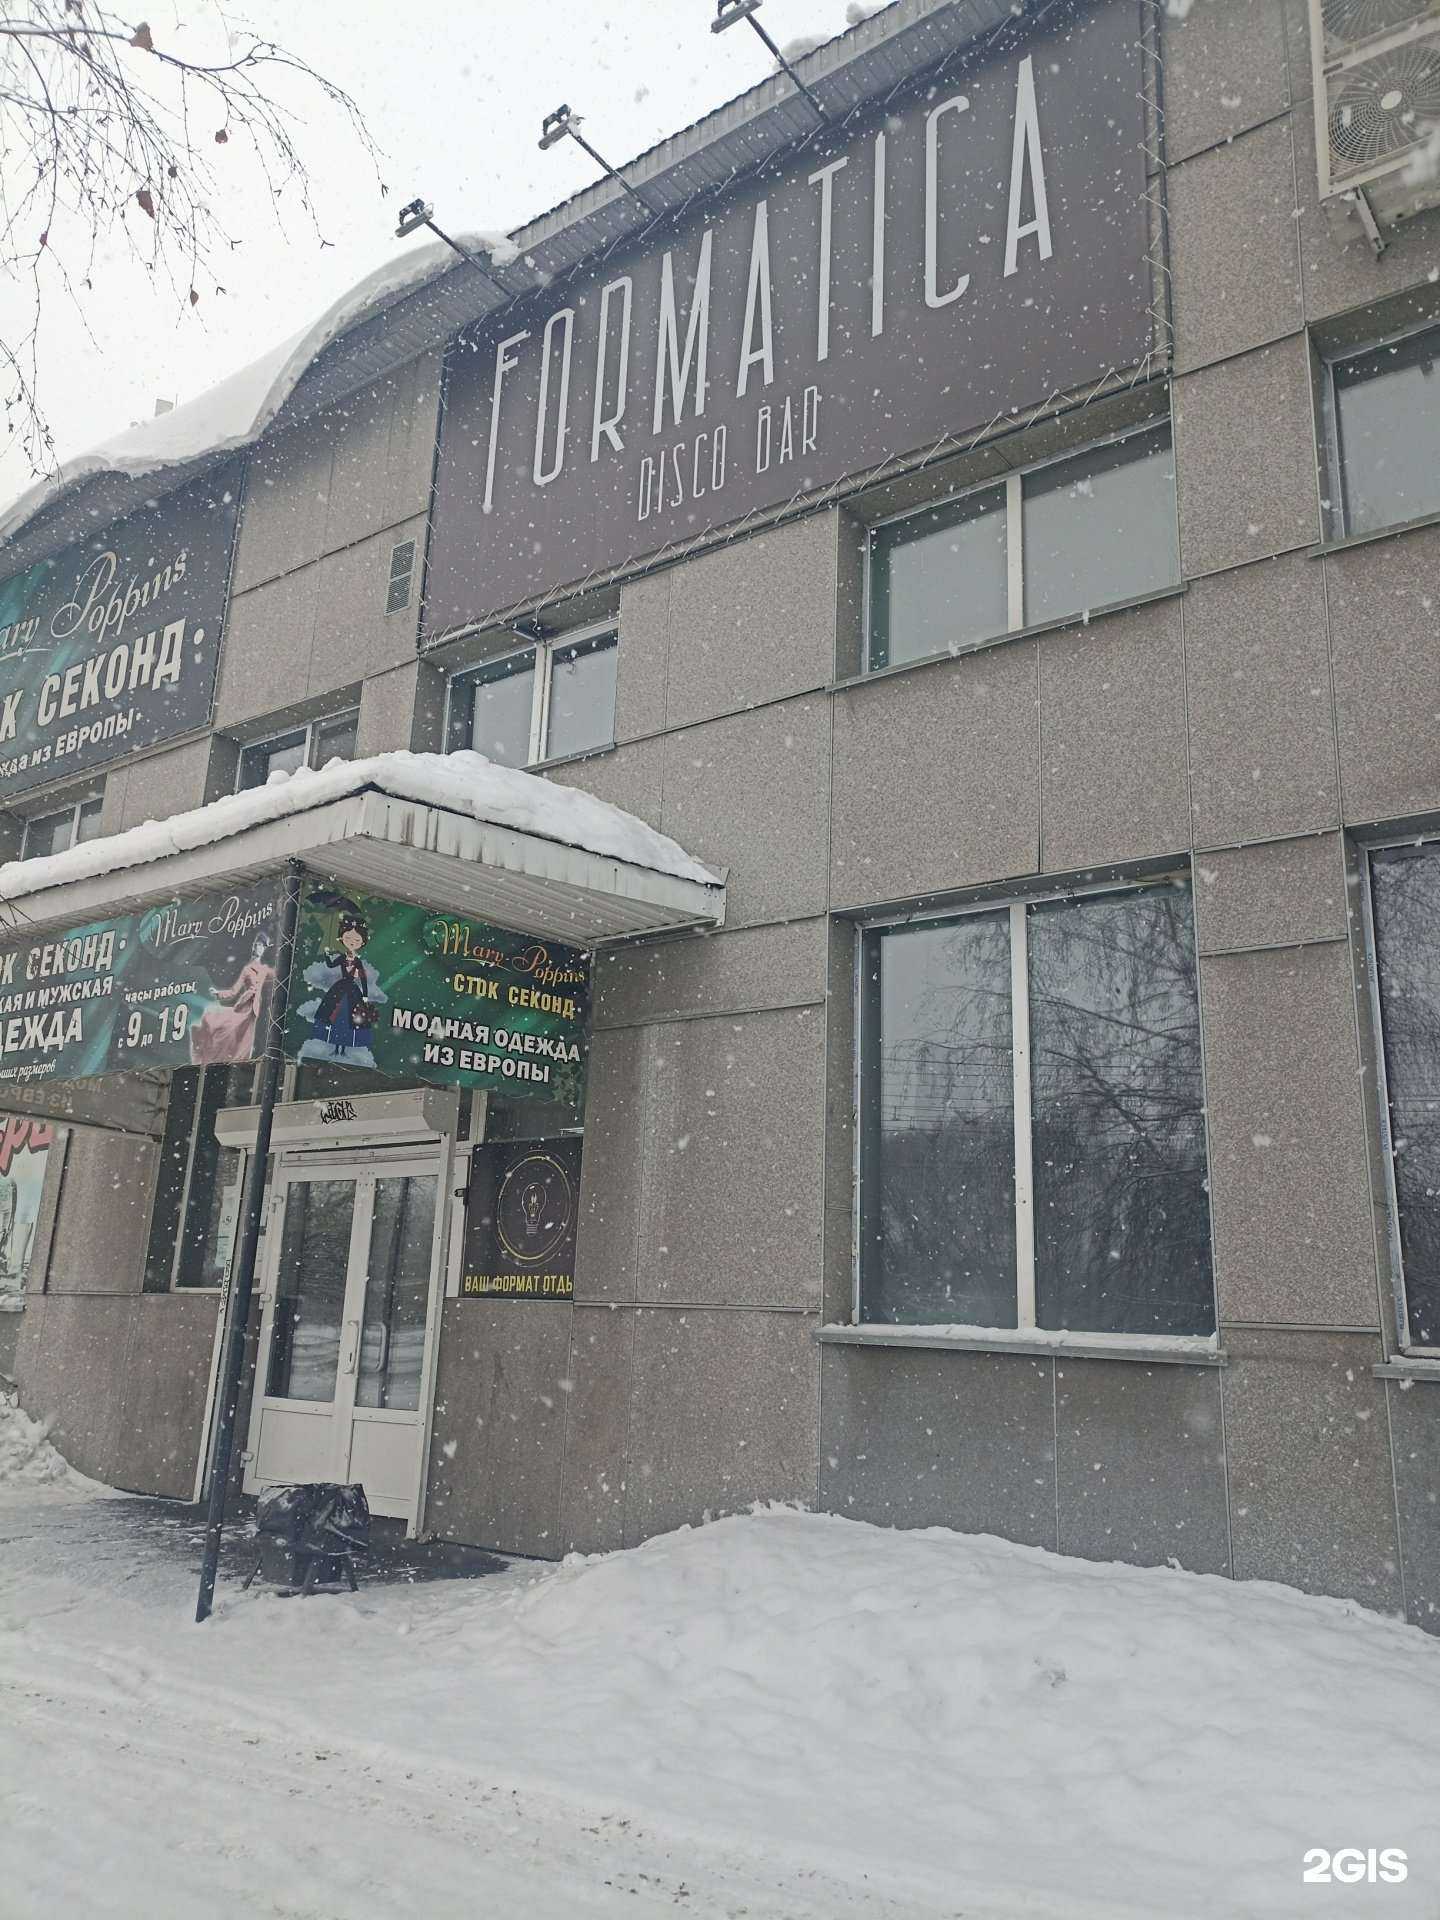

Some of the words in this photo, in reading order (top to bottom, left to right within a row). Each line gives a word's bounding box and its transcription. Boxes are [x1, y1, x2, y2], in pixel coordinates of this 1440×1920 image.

[482, 54, 1054, 514] FORMATICA
[636, 425, 728, 522] DISCO
[755, 385, 819, 475] BAR
[51, 551, 187, 643] Poppins
[37, 617, 187, 727] СЕКОНД
[55, 710, 134, 758] ЕВРОПЫ
[152, 908, 209, 947] Mary
[208, 896, 274, 938] Poppins
[25, 929, 117, 981] СЕКОНД
[432, 919, 505, 969] Mary
[511, 945, 586, 986] Poppins
[38, 975, 114, 1007] МУЖСКАЯ
[125, 987, 153, 1004] часы
[153, 980, 196, 1001] работы
[453, 973, 500, 1001] СТОК
[508, 985, 577, 1021] СЕКОНД
[0, 1007, 83, 1060] ЕЖДА
[126, 1011, 142, 1048] 9
[140, 1032, 153, 1048] до
[158, 1003, 188, 1044] 19
[392, 1008, 490, 1046] МОДНАЯ
[494, 1029, 581, 1064] ОДЕЖДА
[16, 1057, 57, 1083] размеров
[424, 1043, 455, 1067] ИЗ
[459, 1050, 551, 1084] ЕВРОПЫ
[464, 1275, 490, 1293] ВАШ
[492, 1274, 541, 1293] ФОРМАТ
